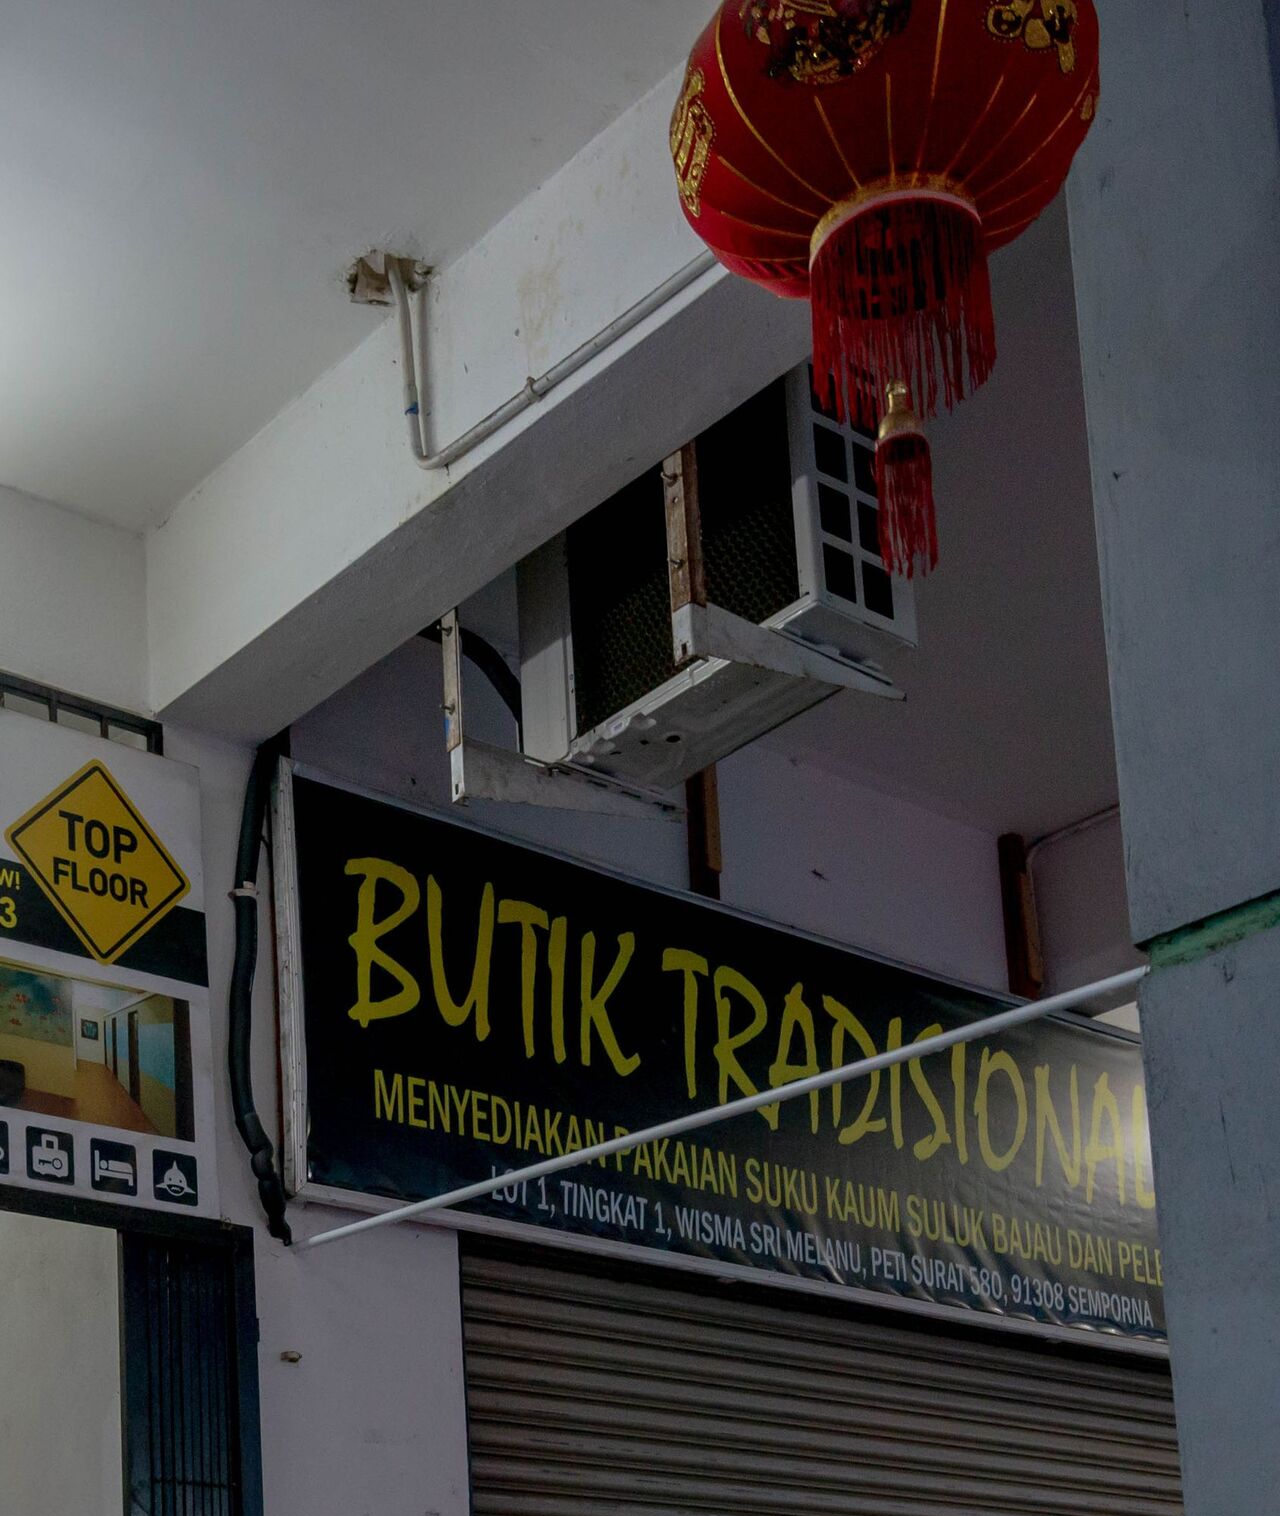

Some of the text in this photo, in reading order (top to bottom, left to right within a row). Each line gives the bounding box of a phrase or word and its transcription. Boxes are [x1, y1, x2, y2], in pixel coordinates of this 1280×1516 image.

[52, 857, 150, 909] FLOOR
[58, 810, 138, 865] TOP
[344, 857, 1156, 1209] BUTIK TRADISIONAL
[374, 1069, 607, 1168] MENYEDIAKAN
[613, 1125, 738, 1198] PAKAIAN
[745, 1158, 818, 1214] SUKU
[825, 1176, 900, 1233] KAUM
[906, 1194, 987, 1250] SULUK
[992, 1213, 1062, 1265] BAJAU
[1069, 1229, 1113, 1277] DAN
[538, 1176, 555, 1218] 1,
[560, 1180, 647, 1230] TINGKAT
[654, 1202, 672, 1241] 1,
[675, 1206, 746, 1251] WISMA
[750, 1222, 781, 1258] SRI
[871, 1247, 908, 1282] PETI
[911, 1256, 965, 1293] SURAT
[1011, 1274, 1065, 1311] 91308
[1068, 1286, 1154, 1328] SEMPORNA
